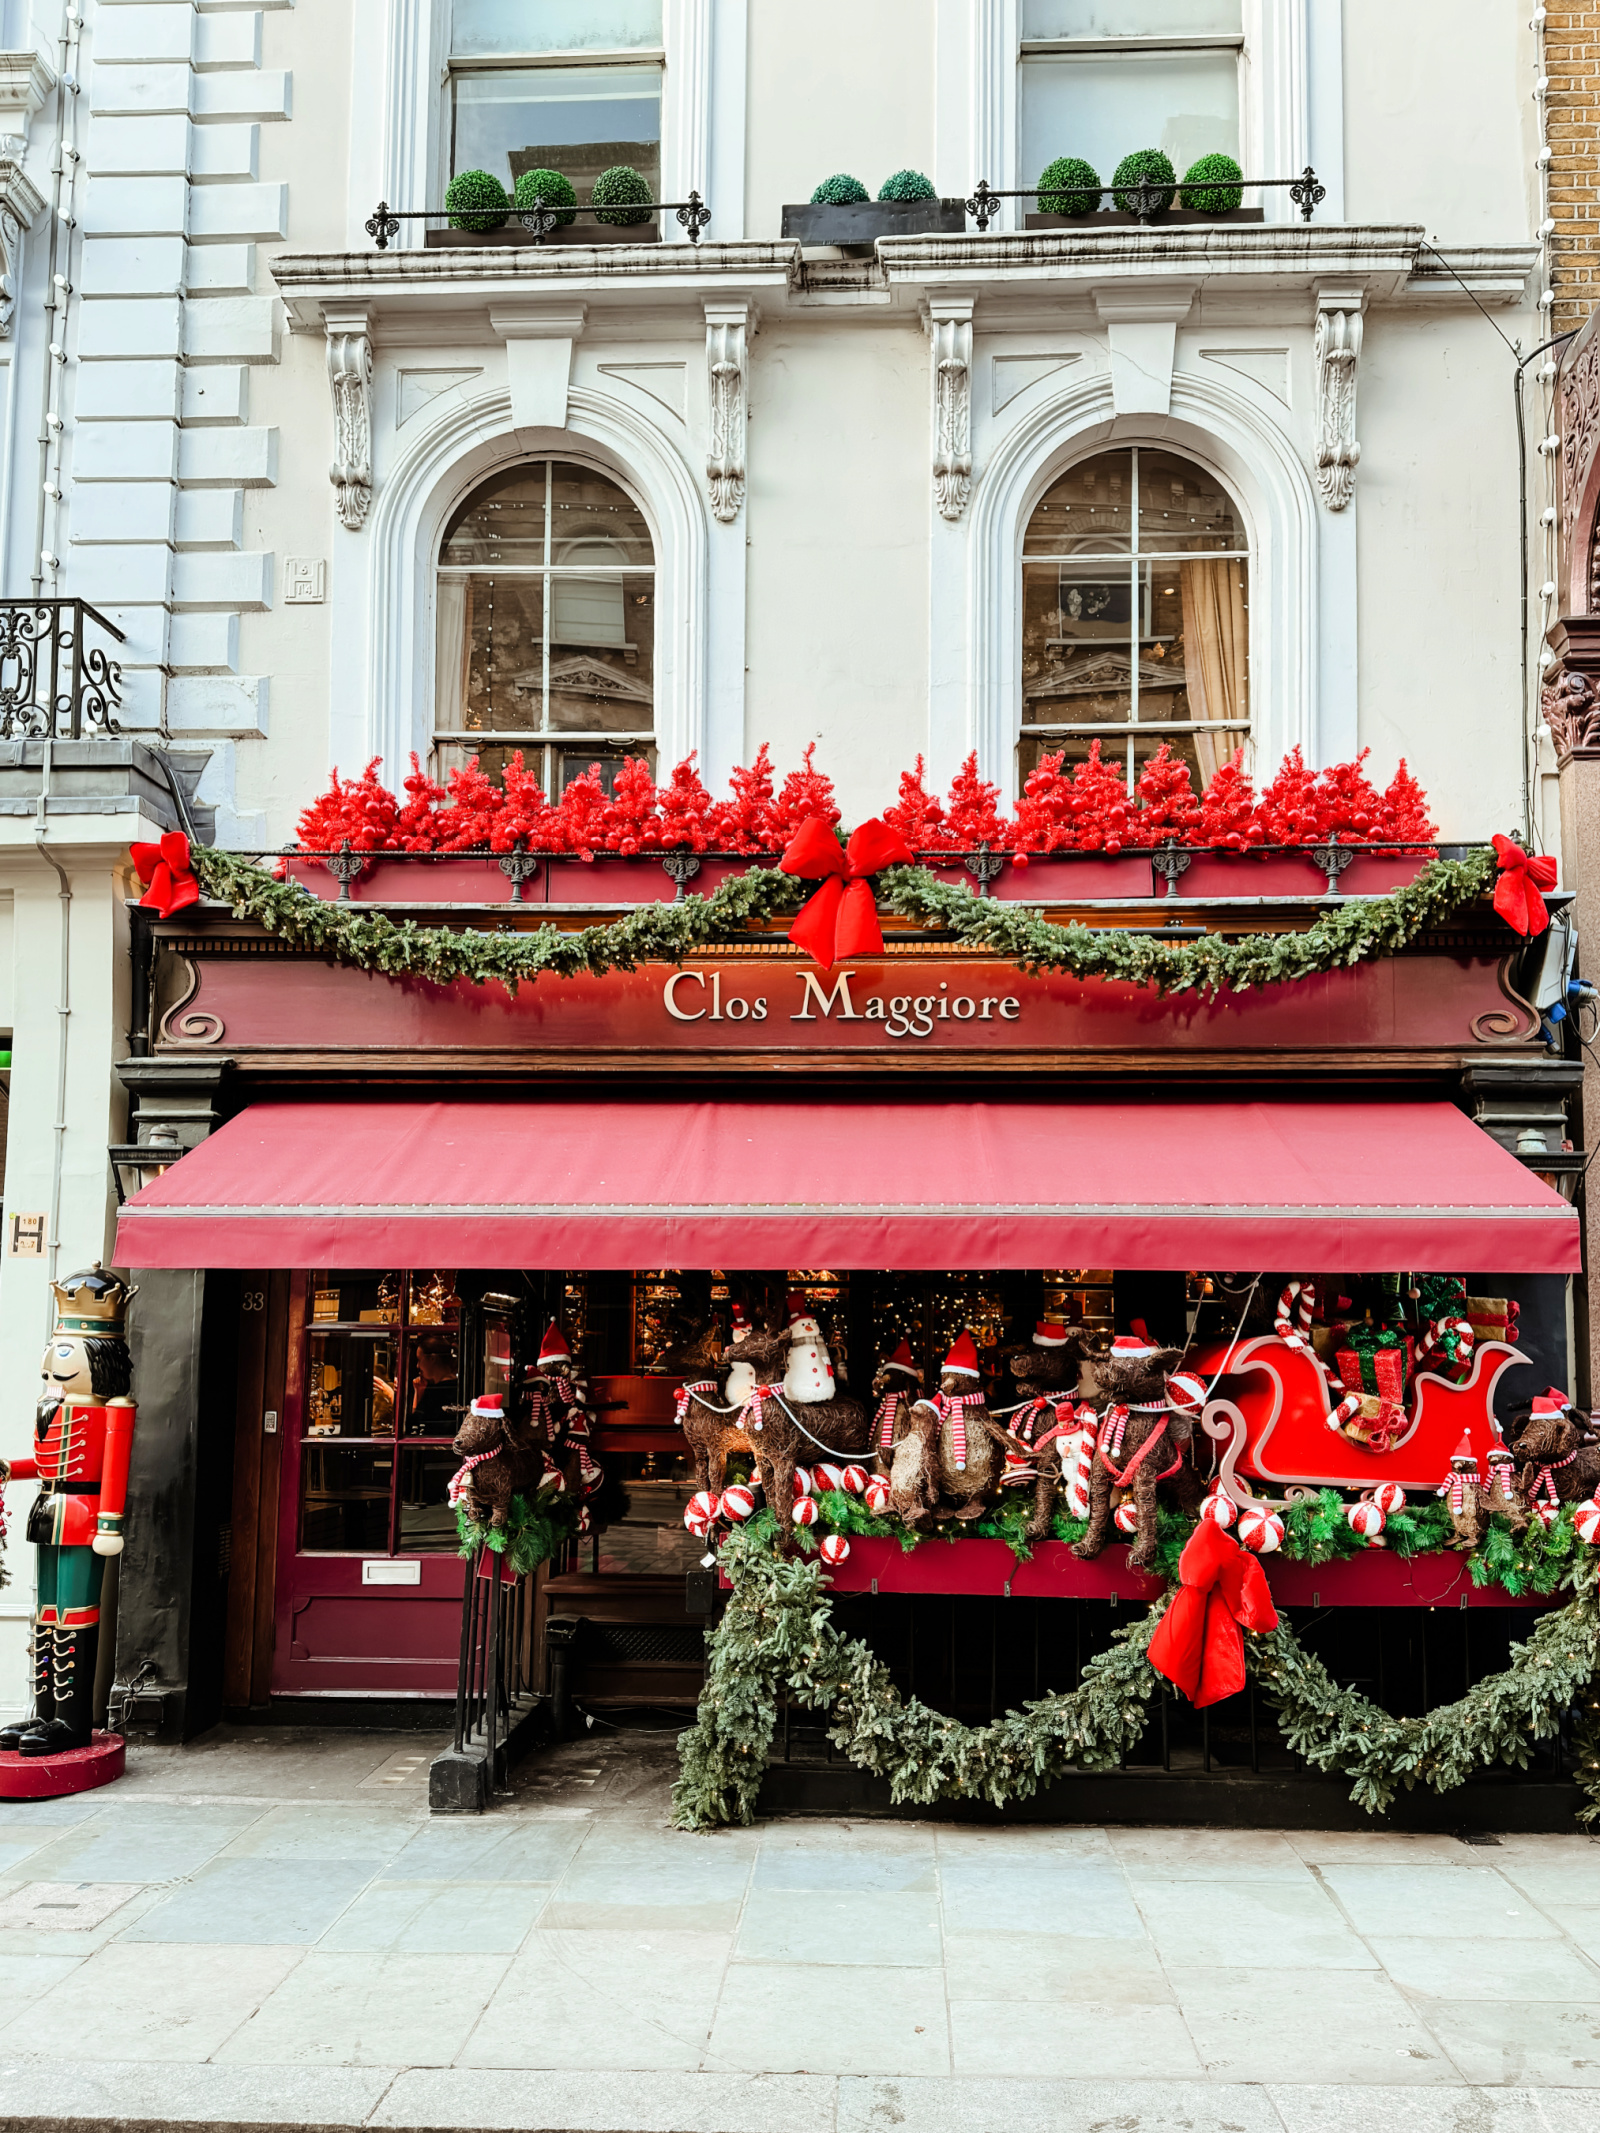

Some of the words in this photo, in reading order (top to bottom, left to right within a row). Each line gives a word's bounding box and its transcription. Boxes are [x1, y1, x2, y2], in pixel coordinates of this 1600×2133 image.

[663, 971, 768, 1021] Clos
[790, 971, 1021, 1037] Maggiore
[13, 1215, 44, 1253] H
[242, 1291, 264, 1311] 33
